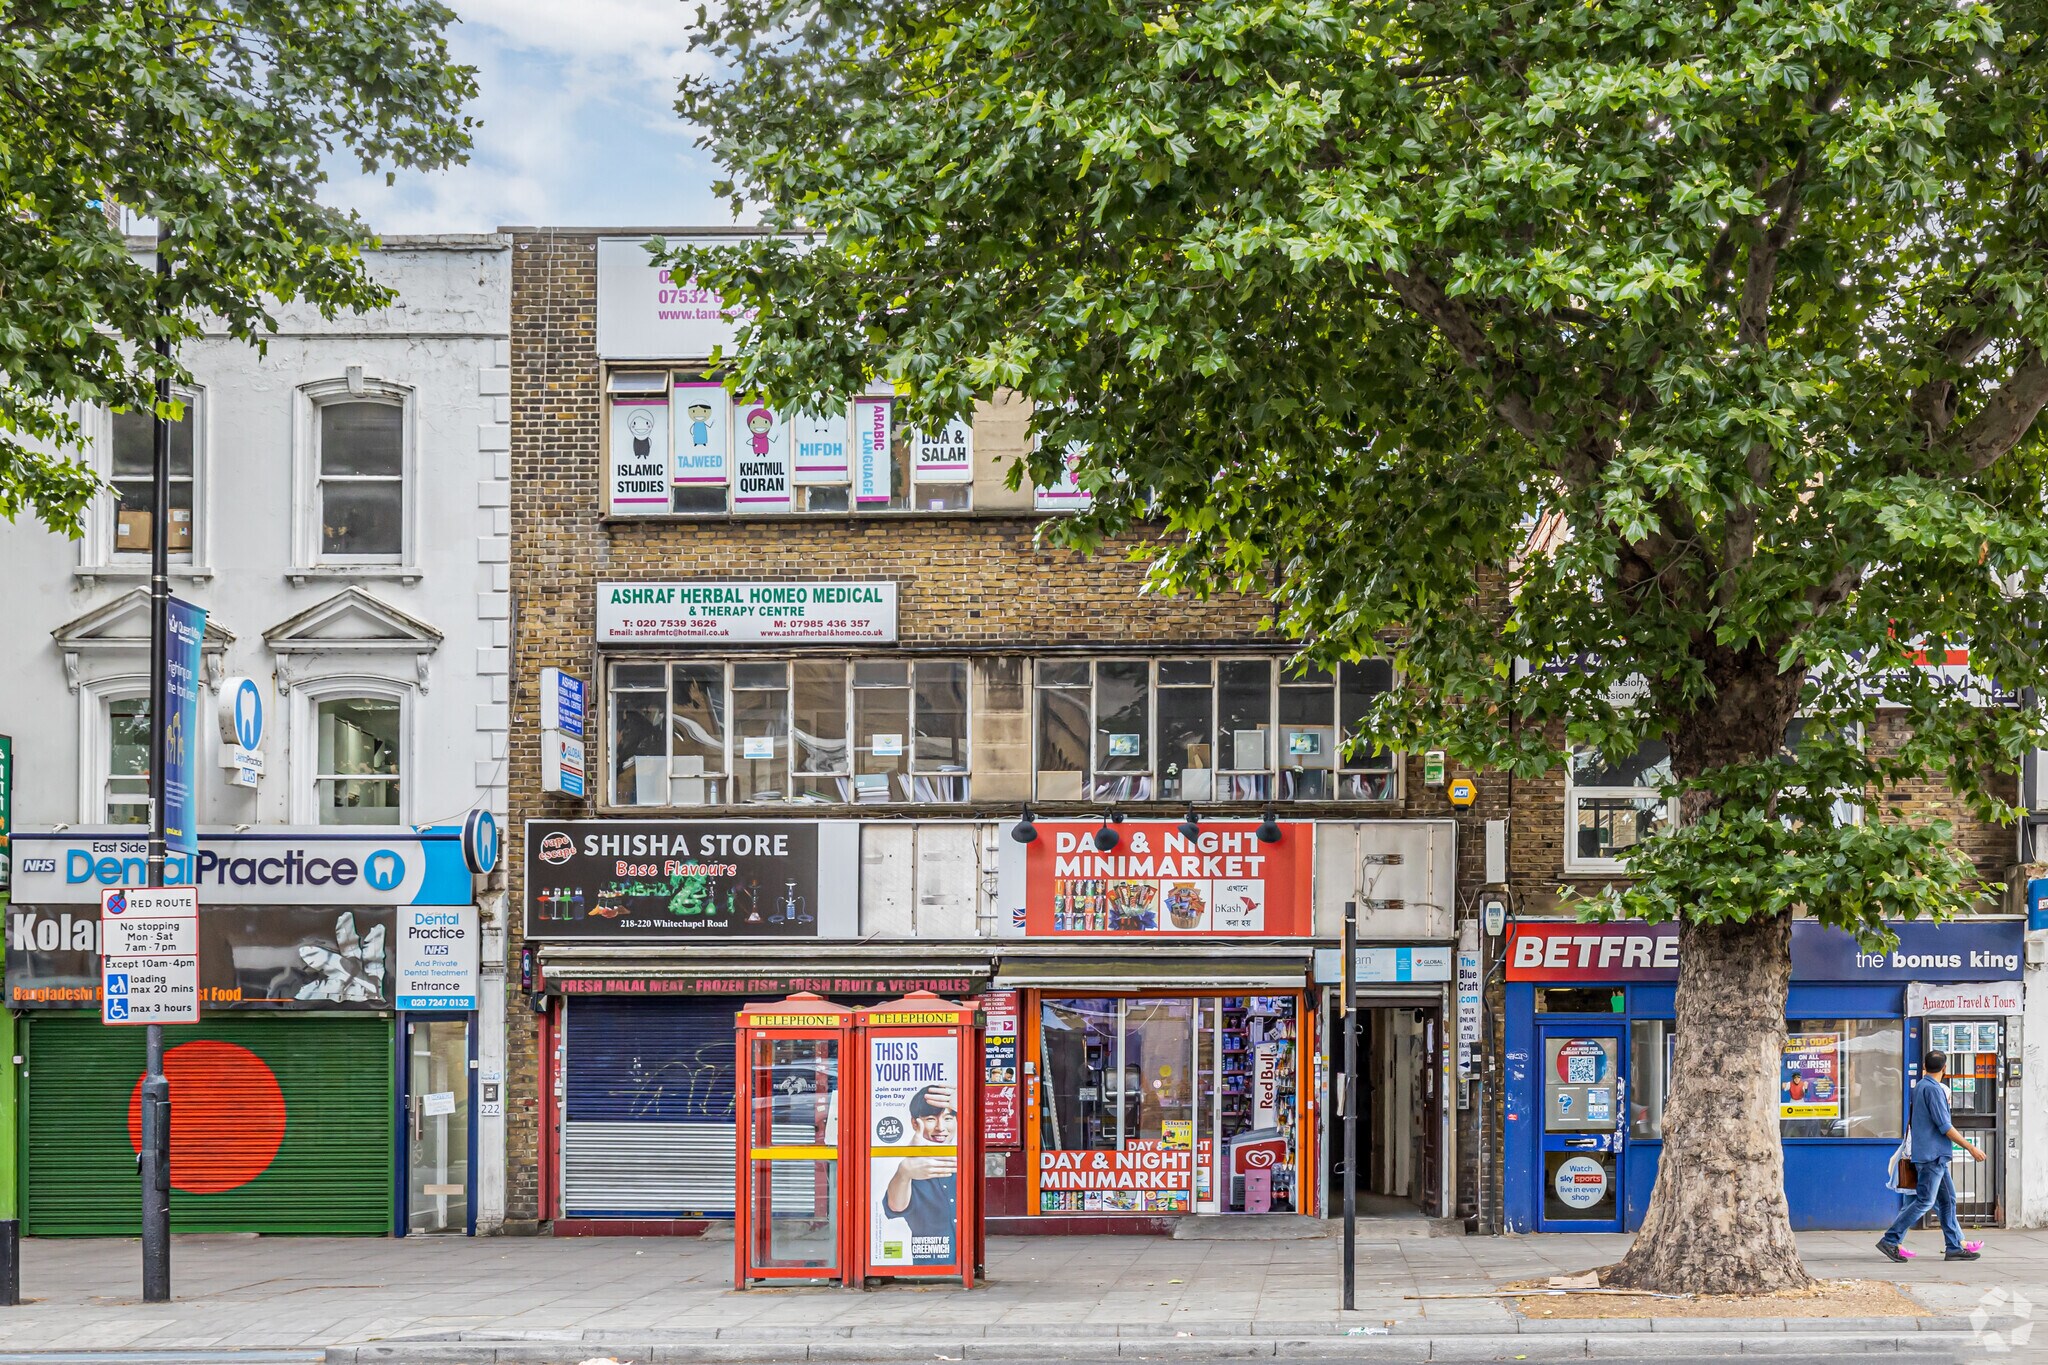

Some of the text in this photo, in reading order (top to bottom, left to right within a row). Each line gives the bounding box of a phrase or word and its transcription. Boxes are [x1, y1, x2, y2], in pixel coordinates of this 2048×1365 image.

[658, 290, 708, 304] 07532
[874, 406, 884, 450] ARABIC
[954, 430, 965, 444] &
[800, 443, 842, 456] HIFDH
[922, 447, 966, 462] SALAH
[678, 456, 722, 468] TAJWEED
[862, 431, 874, 494] LANGUAGE
[617, 464, 664, 476] ISLAMIC
[740, 462, 784, 476] KHATMUL
[617, 480, 664, 492] STUDIES
[740, 478, 784, 492] QURAN
[611, 588, 883, 604] ASHRAF HERBAL HOMEO MEDICAL
[688, 606, 804, 616] & THERAPY CENTRE
[635, 628, 729, 636] ashrafmtc@hotmail.co.uk
[92, 842, 146, 852] East Side
[544, 837, 568, 848] vape
[584, 834, 788, 856] SHISHA STORE
[1131, 832, 1150, 854] &
[539, 846, 576, 860] escape
[24, 860, 55, 871] NHS
[616, 860, 738, 876] Base Flavours
[1055, 856, 1265, 877] MINIMARKET
[130, 898, 192, 908] RED ROUTE
[1215, 904, 1242, 912] bKash
[415, 913, 459, 925] Dental
[620, 919, 728, 930] 218-220 Whitechapel Road
[138, 922, 180, 931] stopping
[156, 932, 173, 940] Sat
[409, 927, 464, 939] Practice
[425, 945, 448, 955] NHS
[106, 960, 138, 968] Except
[1460, 958, 1476, 966] The
[1856, 950, 2018, 971] the bonus king
[130, 975, 166, 984] loading
[1460, 970, 1477, 979] Blue
[154, 985, 168, 993] 20
[171, 984, 194, 992] mins
[412, 981, 460, 990] Entrance
[561, 978, 970, 992] FRESH HALAL MEAT FROZEN FISH FRESH FRUIT & VEGETABLES
[1458, 982, 1478, 992] Craft
[13, 986, 93, 1002] Bangladeshi
[212, 987, 242, 1001] Food
[1459, 996, 1478, 1004] .com
[1922, 995, 2016, 1010] Amazon Travel & Tours
[154, 1004, 160, 1012] 3
[756, 1016, 834, 1026] TELEPHONE
[876, 1014, 953, 1024] TELEPHONE
[1810, 1038, 1834, 1046] ODDS
[875, 1042, 918, 1061] THIS IS
[875, 1063, 948, 1082] YOUR TIME.
[1260, 1054, 1277, 1108] Red Bull
[481, 1104, 500, 1114] 222
[879, 1125, 900, 1136] £4k
[1128, 1141, 1154, 1150] DAY
[1040, 1152, 1190, 1169] DAY & NIGHT
[1040, 1172, 1190, 1188] MINIMARKET
[1560, 1176, 1601, 1184] sky sports
[912, 1236, 950, 1244] UNIVERSITY OF
[912, 1244, 950, 1254] GREENWICH
